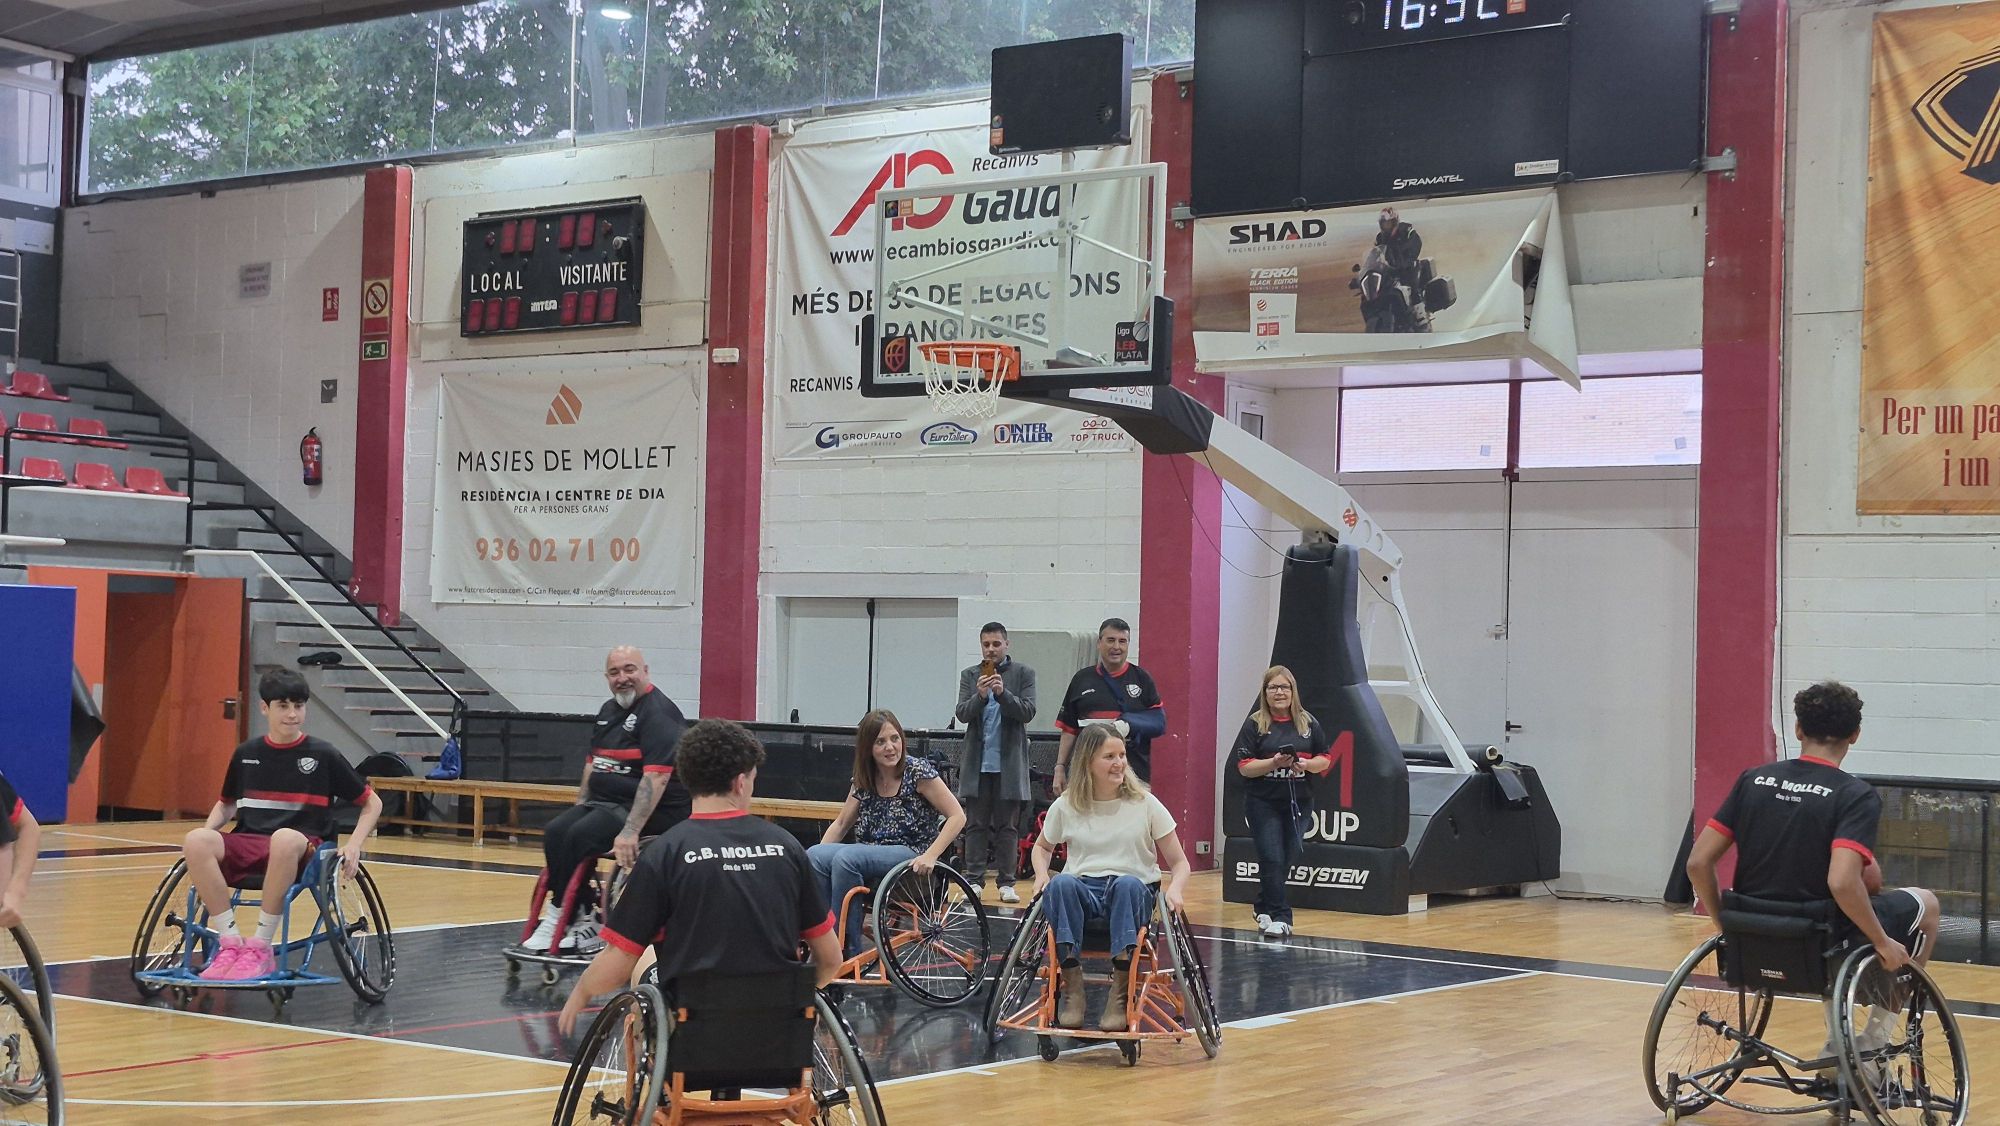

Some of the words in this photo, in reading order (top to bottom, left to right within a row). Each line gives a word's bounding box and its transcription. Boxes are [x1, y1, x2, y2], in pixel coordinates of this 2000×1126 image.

[962, 184, 1077, 225] Gaud
[1229, 219, 1327, 245] SHAD
[470, 270, 523, 293] LOCAL
[560, 261, 628, 286] VISITANTE
[1249, 266, 1298, 279] TERRA
[1249, 279, 1271, 287] BLACK
[1274, 278, 1298, 286] EDITION
[792, 286, 839, 315] MÉS
[1117, 327, 1130, 337] Liga
[1116, 340, 1136, 351] LEB
[1116, 350, 1143, 360] PLATA
[790, 375, 853, 393] RECANVIS
[1882, 397, 1926, 435] Per
[1934, 404, 1964, 434] un
[1010, 422, 1047, 434] INTER
[841, 431, 902, 441] GROUPAUTO
[930, 432, 969, 442] EuroTaller
[1010, 432, 1053, 443] TALLER
[1071, 433, 1089, 442] TOP
[1092, 432, 1125, 441] TRUCK
[457, 450, 534, 472] MASIES
[544, 449, 572, 472] DE
[584, 446, 676, 470] MOLLET
[1943, 448, 1951, 487] i
[1960, 457, 1989, 487] un
[461, 488, 541, 502] RESIDÈNCIA
[546, 490, 550, 502] I
[555, 489, 611, 501] CENTRE
[616, 488, 633, 500] DE
[639, 488, 665, 500] DIA
[513, 505, 528, 514] PER
[531, 505, 537, 514] A
[539, 505, 579, 514] PERSONES
[582, 504, 609, 514] GRANS
[475, 537, 520, 562] 936
[529, 537, 558, 562] 02
[568, 537, 595, 562] 71
[610, 537, 640, 562] 00
[1754, 775, 1778, 788] C.B.
[1781, 779, 1833, 797] MOLLET
[684, 847, 718, 864] C.B.
[720, 844, 785, 859] MOLLET
